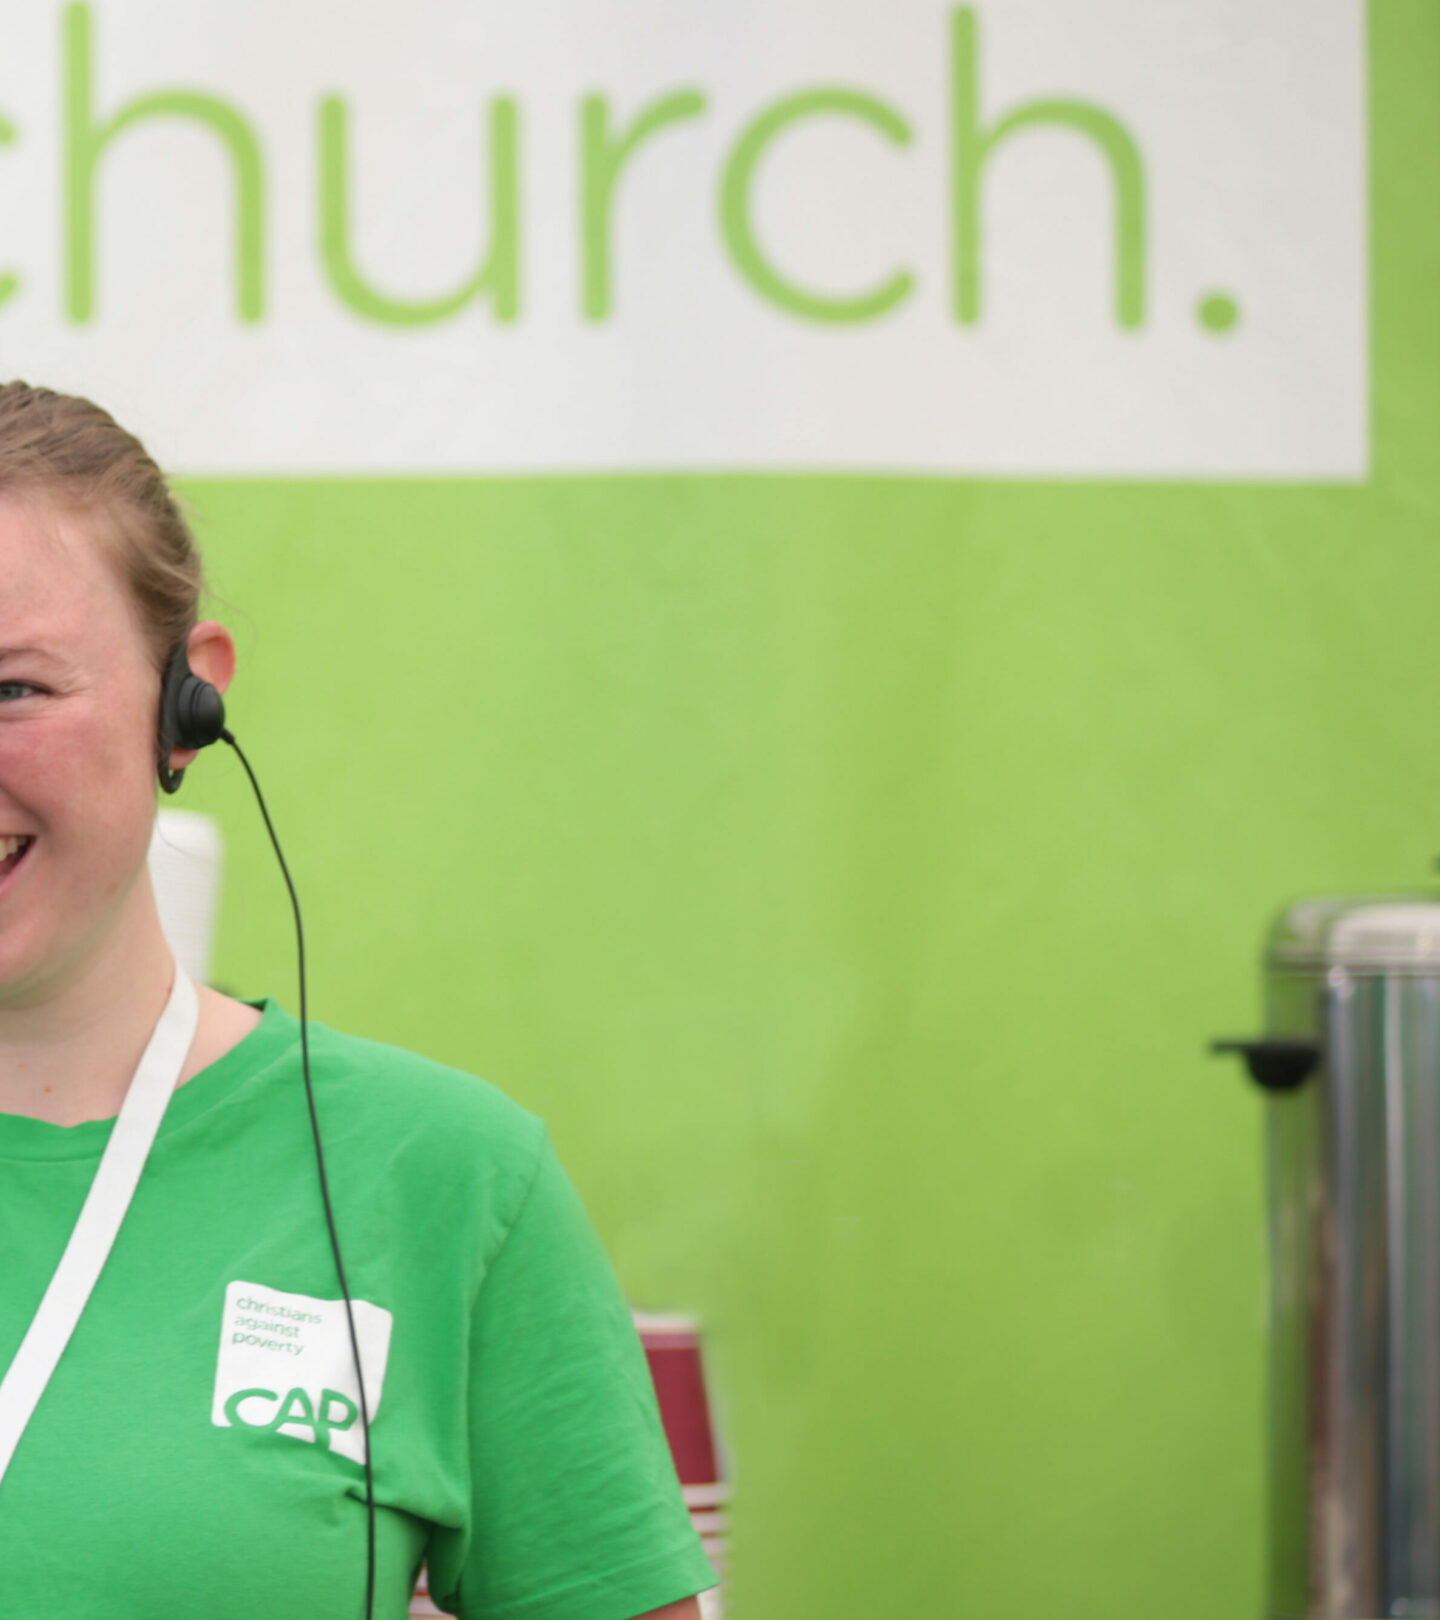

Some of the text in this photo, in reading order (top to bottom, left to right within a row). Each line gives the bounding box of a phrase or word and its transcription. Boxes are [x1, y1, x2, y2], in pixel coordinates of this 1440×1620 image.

[236, 1296, 322, 1324] christians
[233, 1315, 301, 1338] against
[231, 1331, 304, 1356] poverty
[223, 1387, 359, 1450] CAP
